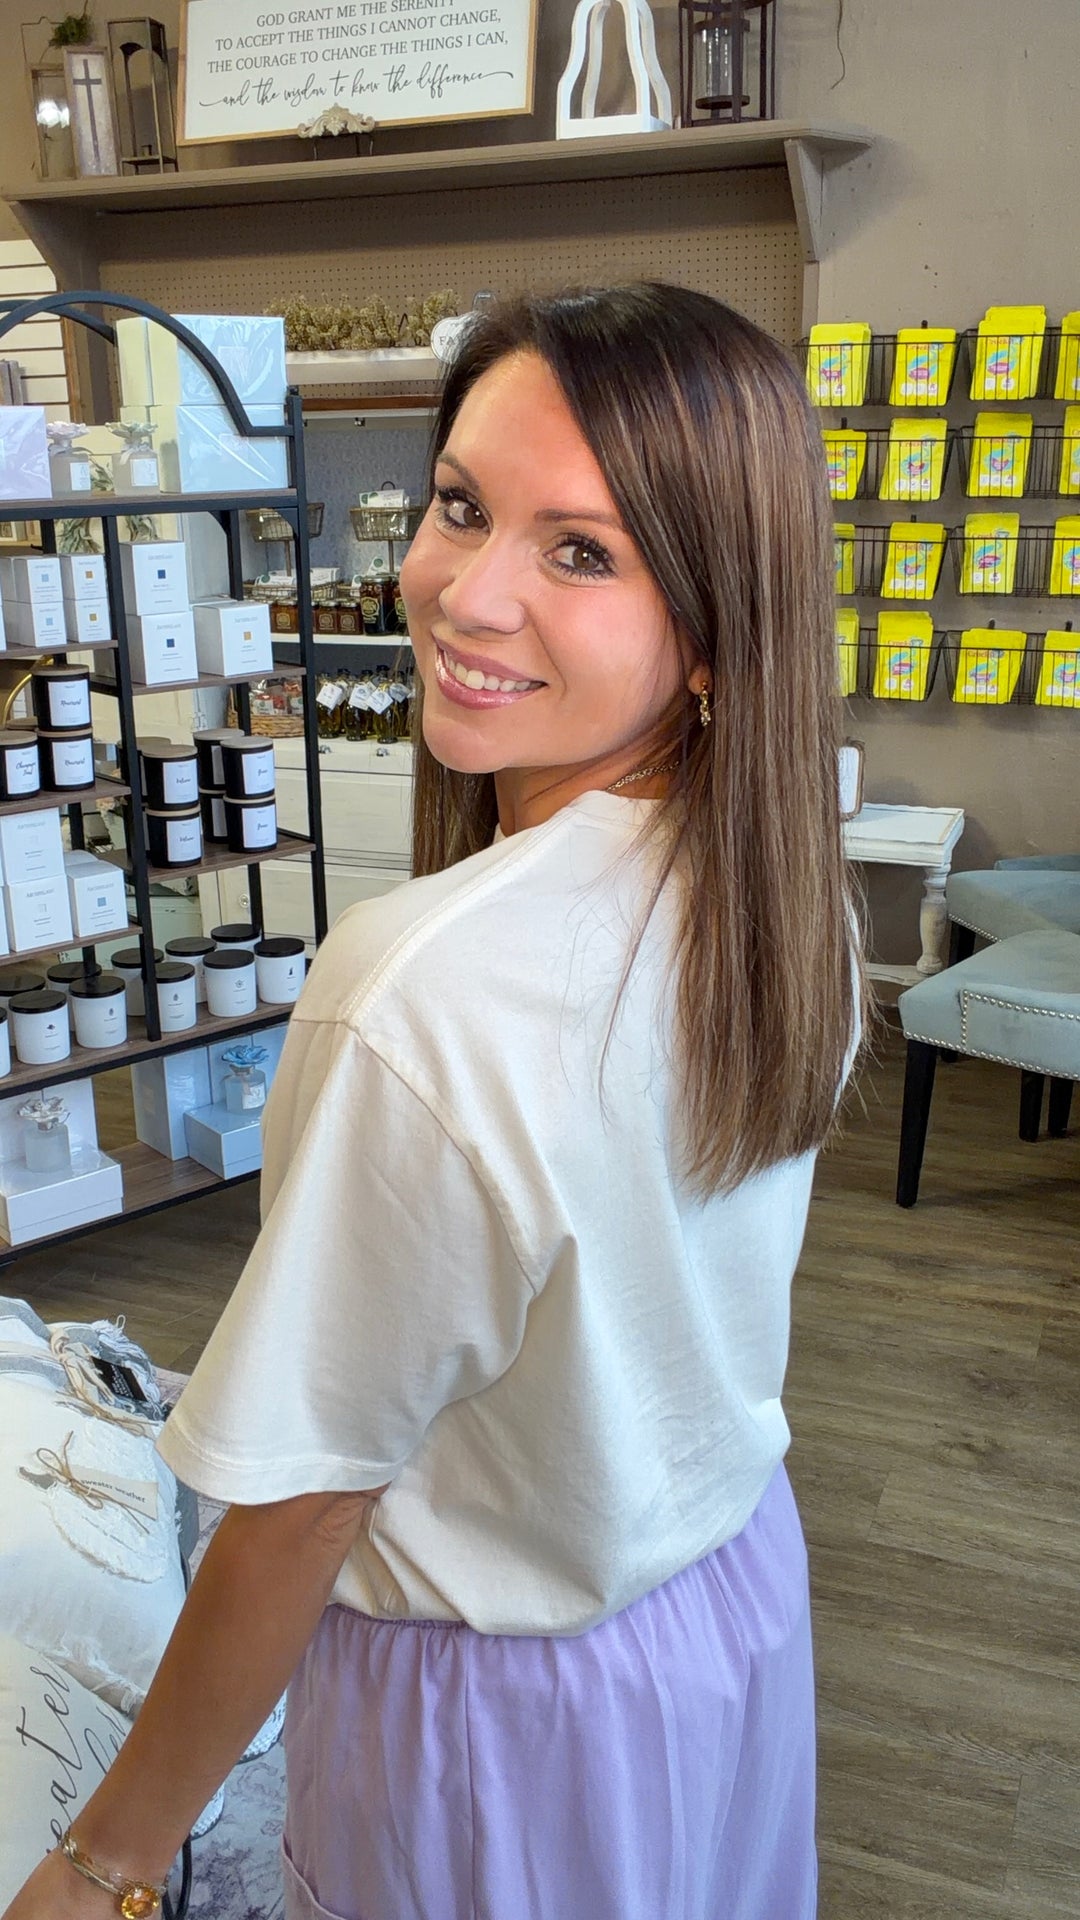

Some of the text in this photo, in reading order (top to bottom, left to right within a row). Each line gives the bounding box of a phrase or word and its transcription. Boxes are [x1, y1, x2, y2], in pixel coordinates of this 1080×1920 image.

[215, 9, 501, 51] TO ACCEPT THE THINGS I CANNOT CHANGE,
[256, 13, 285, 27] GOD
[288, 7, 333, 24] GRANT
[336, 4, 357, 19] ME
[360, 1, 387, 16] THE
[207, 30, 509, 73] THE COURAGE TO CHANGE THE THINGS I CAN,
[199, 61, 514, 108] and the wisdom to know the difference
[114, 1487, 146, 1503] weather
